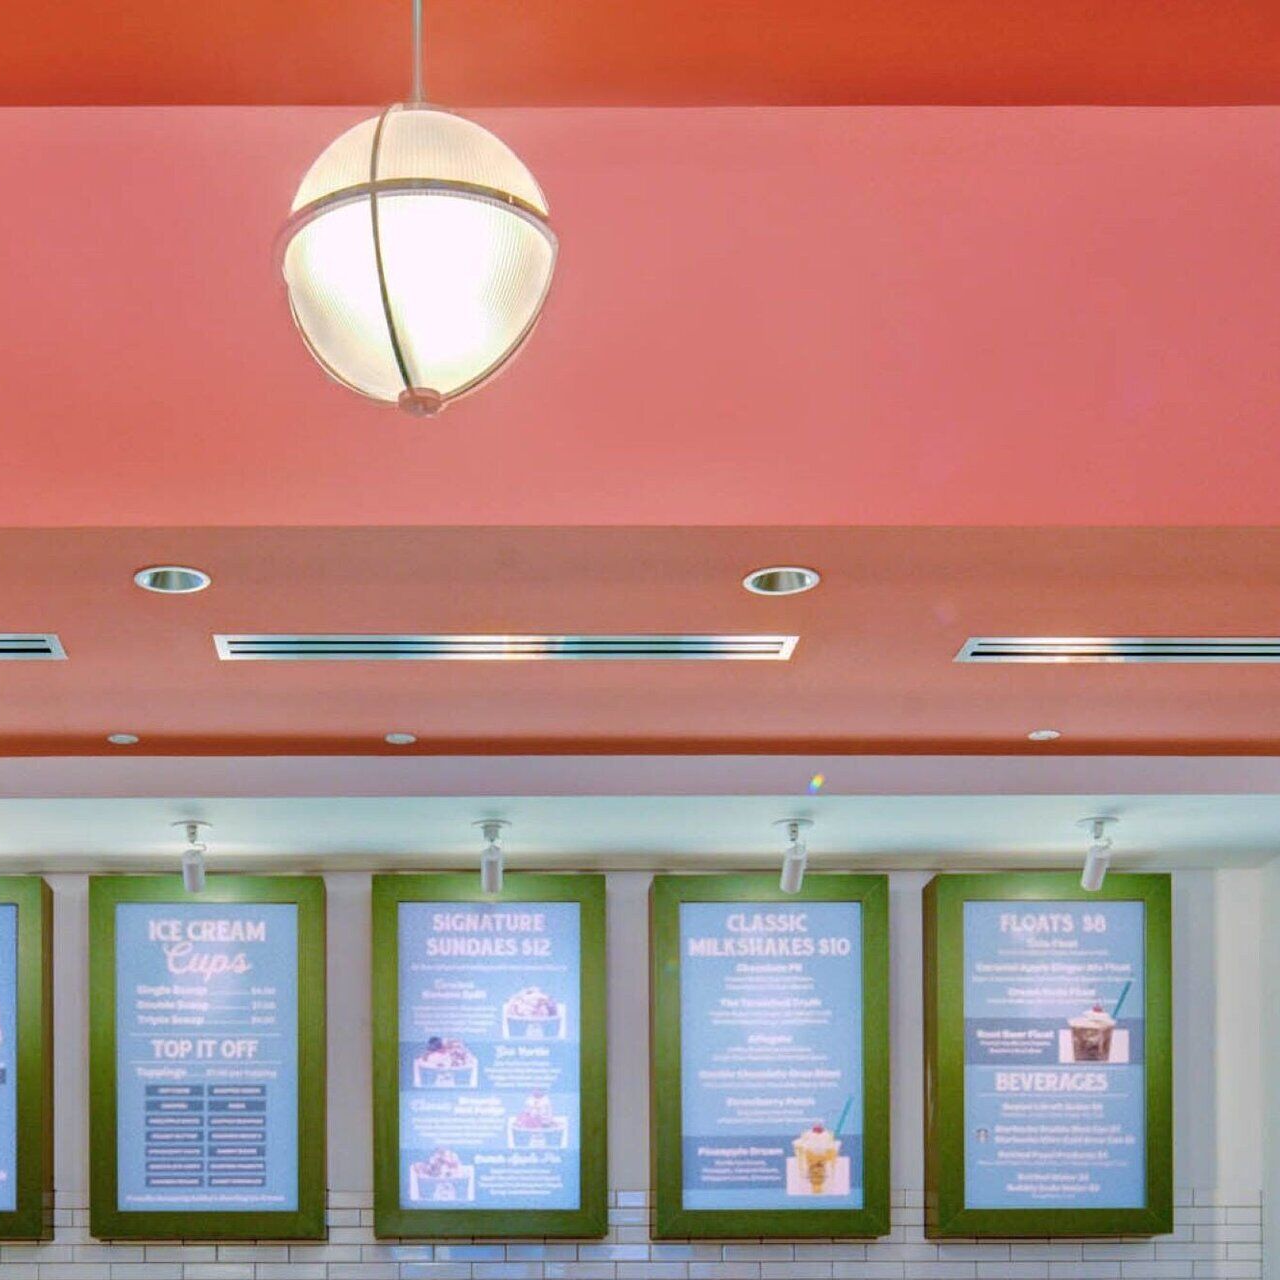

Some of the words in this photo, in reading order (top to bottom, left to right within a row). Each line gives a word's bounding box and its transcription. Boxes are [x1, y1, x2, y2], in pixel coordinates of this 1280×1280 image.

[149, 920, 181, 941] ICE
[187, 920, 266, 941] CREAM
[433, 914, 546, 931] SIGNATURE
[726, 914, 808, 932] CLASSIC
[1000, 914, 1074, 933] FLOATS
[426, 938, 518, 956] SUNDAES
[521, 938, 551, 956] $12
[688, 938, 814, 956] MILKSHAKES
[819, 938, 851, 956] $10
[162, 942, 251, 983] Cups
[152, 1040, 192, 1058] TOP
[196, 1040, 217, 1058] IT
[222, 1040, 259, 1058] OFF
[995, 1073, 1108, 1091] BEVERAGES
